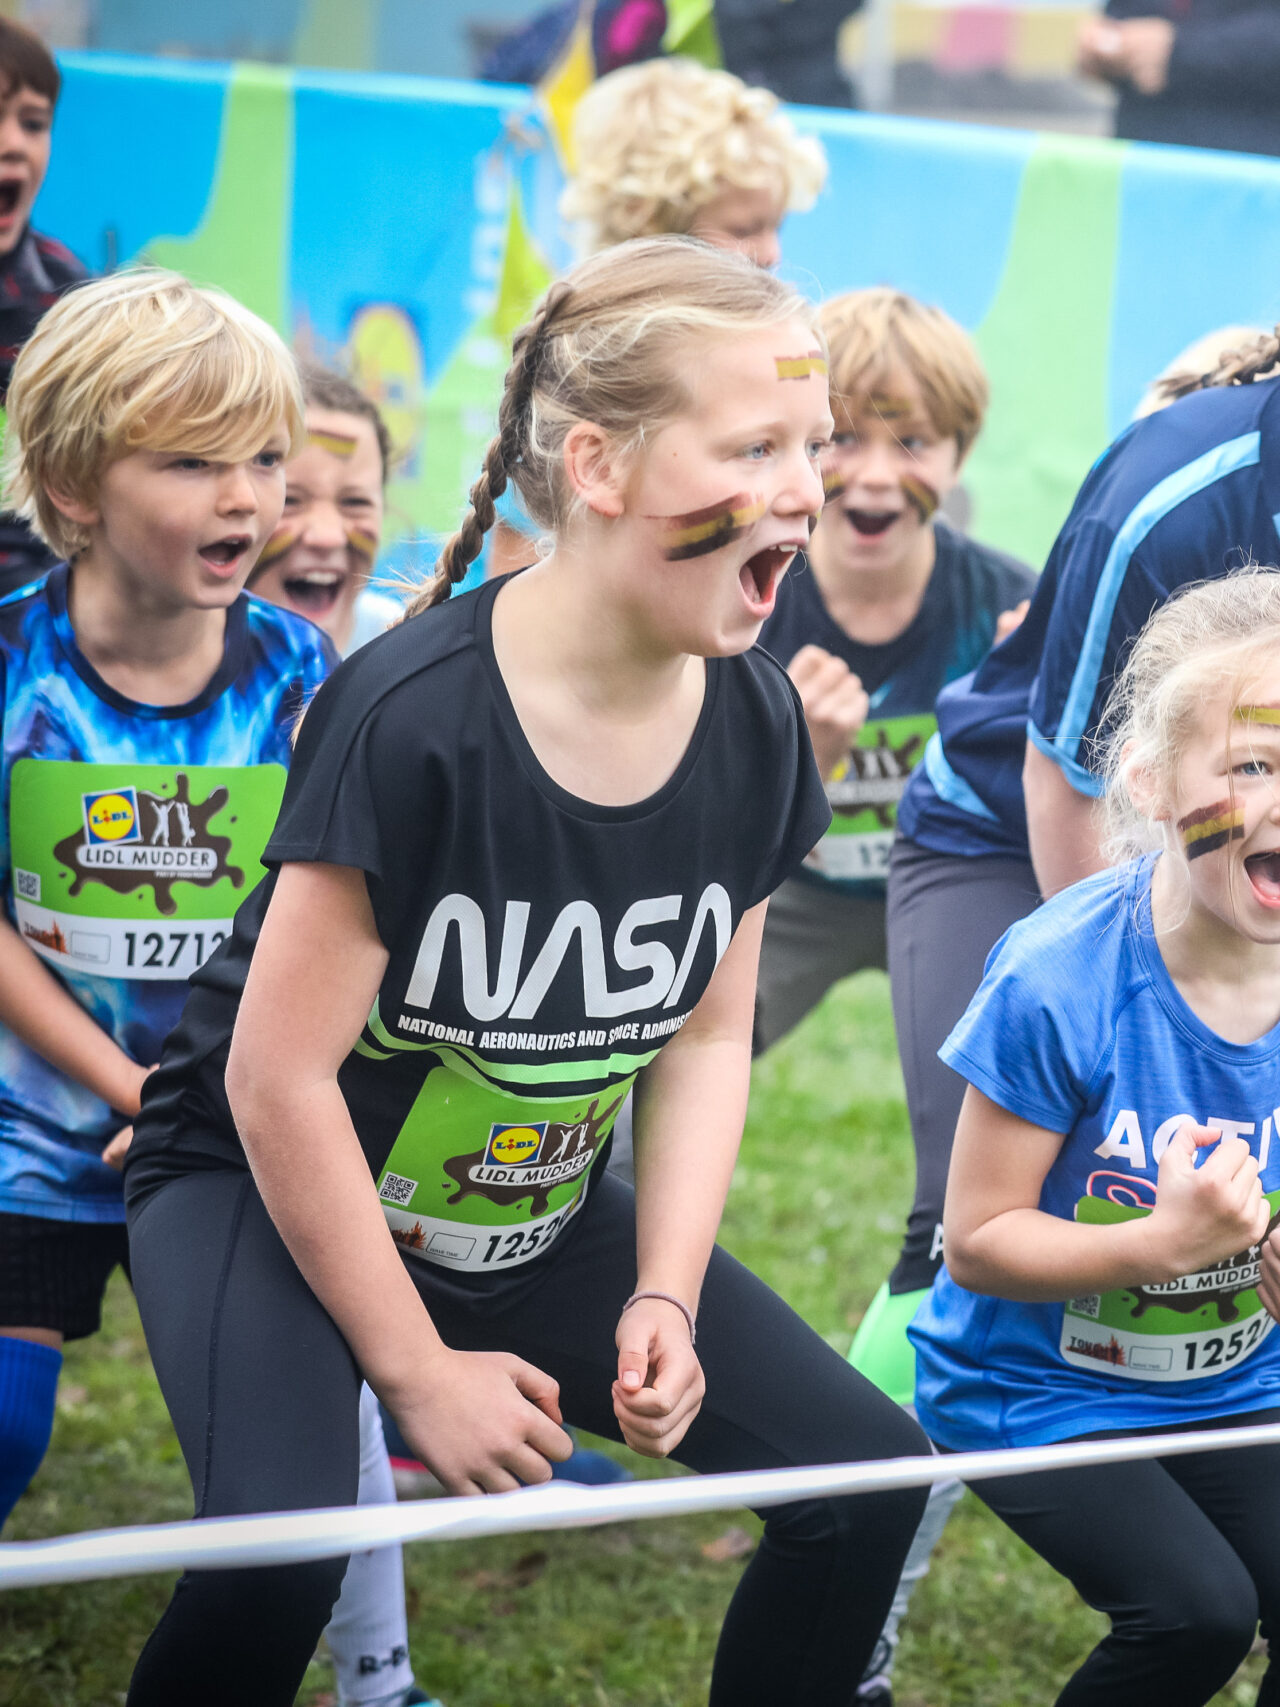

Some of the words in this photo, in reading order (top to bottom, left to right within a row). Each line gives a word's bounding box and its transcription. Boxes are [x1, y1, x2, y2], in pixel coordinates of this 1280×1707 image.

[86, 848, 124, 864] LIDL
[133, 851, 210, 866] MUDDER
[404, 882, 732, 1022] NASA
[397, 1014, 475, 1047] NATIONAL
[479, 1030, 576, 1051] AERONAUTICS
[576, 1029, 606, 1047] AND
[608, 1022, 639, 1045] SPACE
[475, 1167, 516, 1183] LIDL
[521, 1152, 589, 1183] MUDDER
[1196, 1263, 1260, 1289] MUDDE
